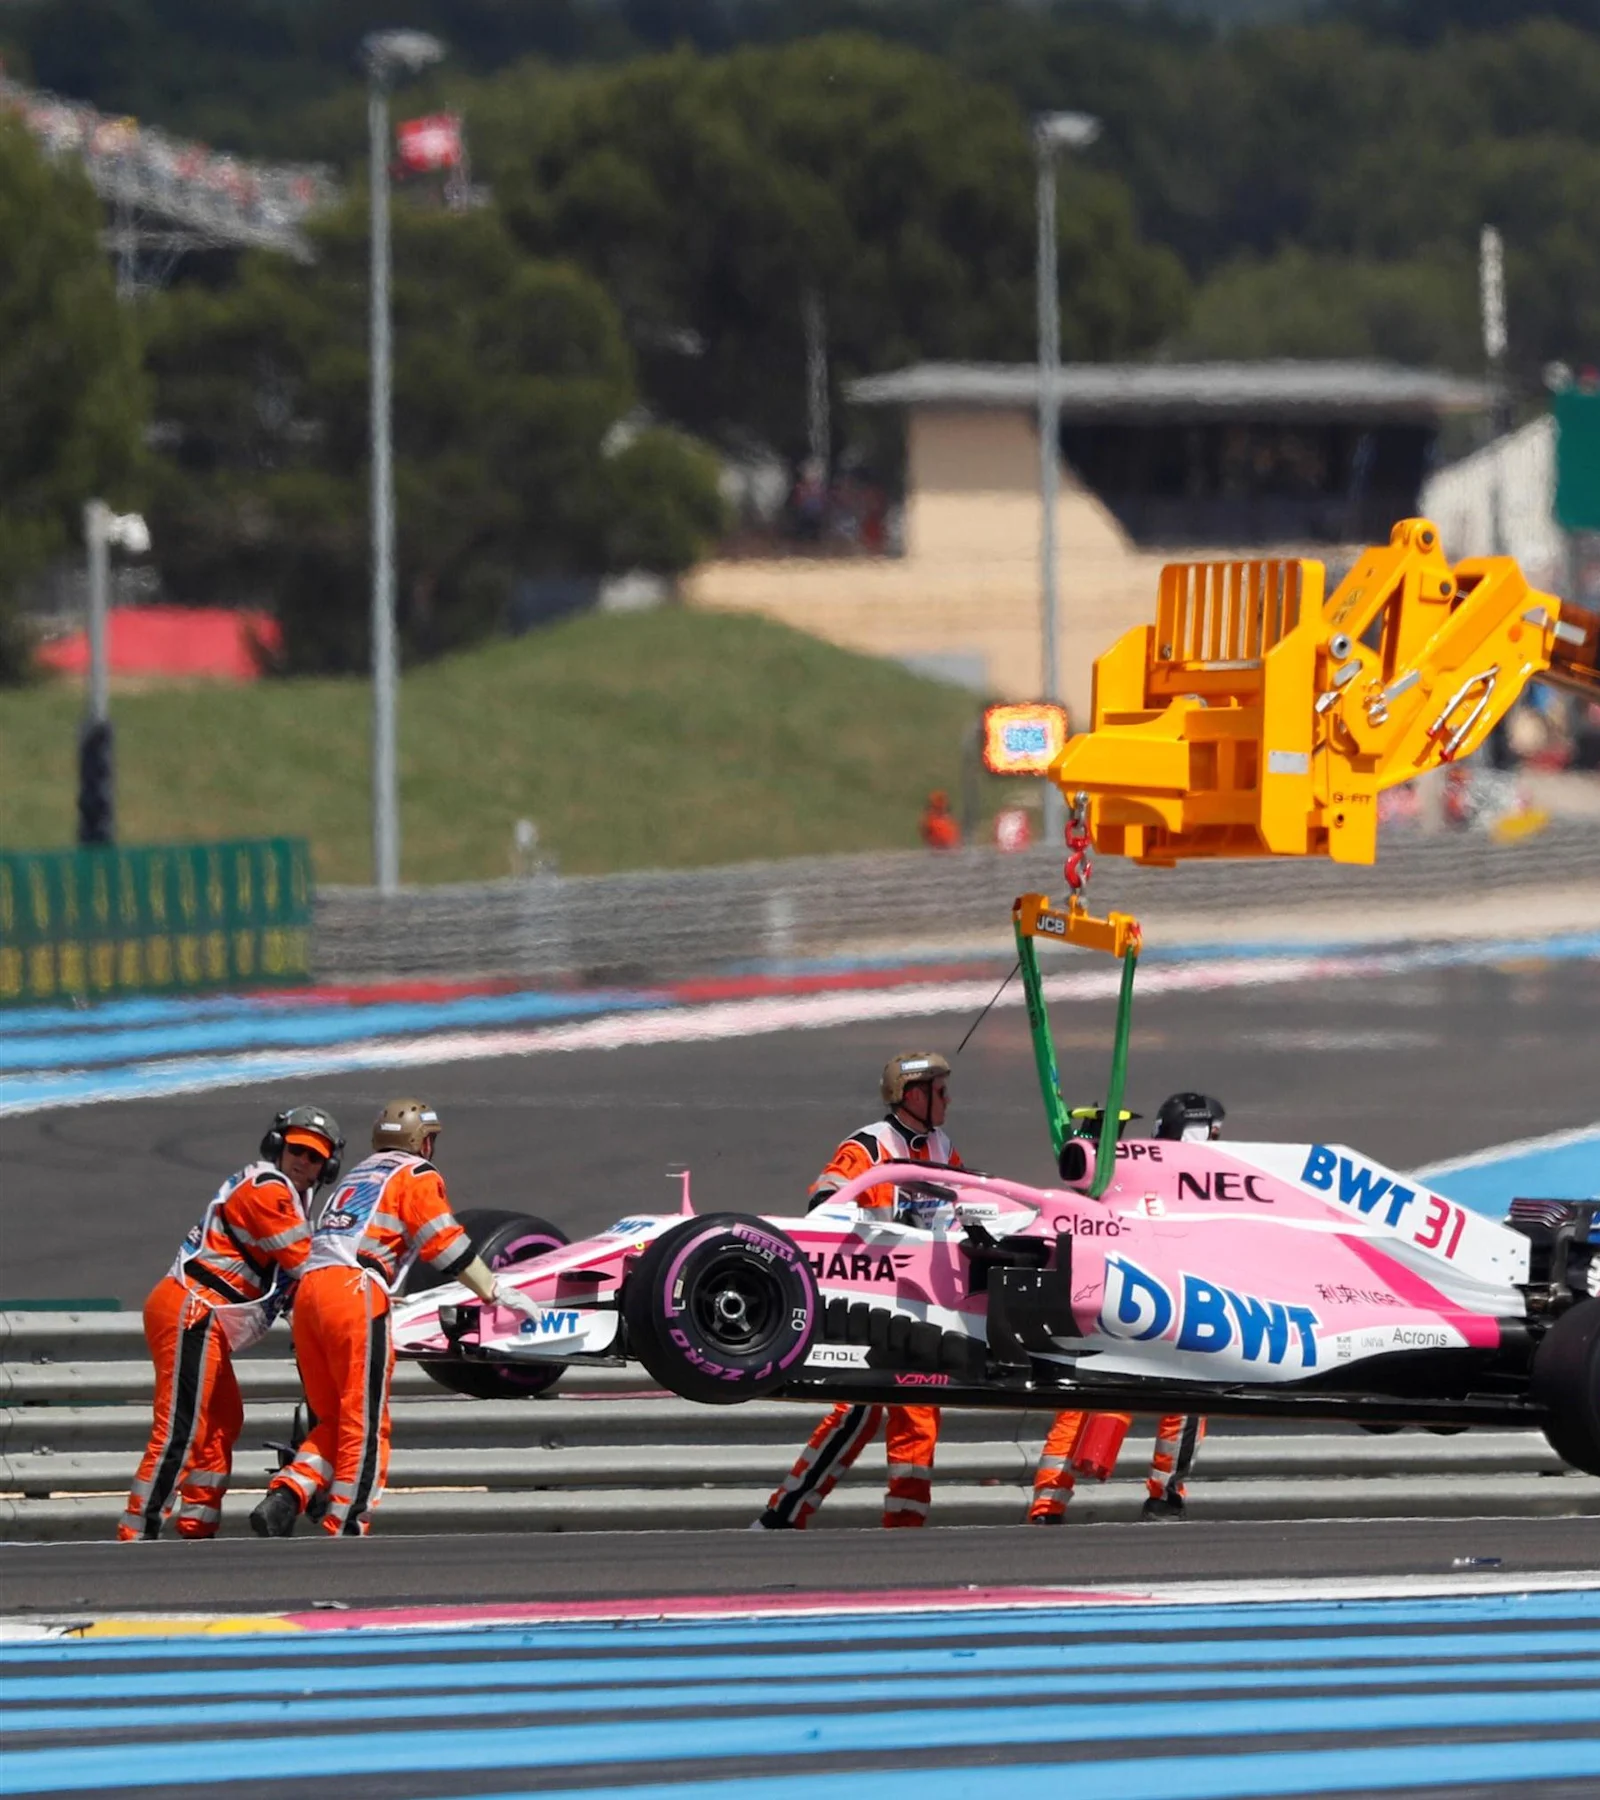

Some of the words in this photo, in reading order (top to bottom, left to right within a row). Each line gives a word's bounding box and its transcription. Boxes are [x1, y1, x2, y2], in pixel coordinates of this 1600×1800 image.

[1037, 915, 1065, 934] JCB
[1115, 1143, 1163, 1162] YPE
[1178, 1172, 1275, 1204] NEC
[1301, 1144, 1415, 1229] BWT
[1414, 1196, 1467, 1259] 31
[1053, 1214, 1120, 1237] Claro
[732, 1223, 796, 1262] PIRELLI
[805, 1252, 897, 1282] HARA
[1176, 1274, 1321, 1368] BWT
[1392, 1326, 1448, 1347] Acronis
[669, 1328, 745, 1381] ZERO
[812, 1350, 860, 1362] ENOL
